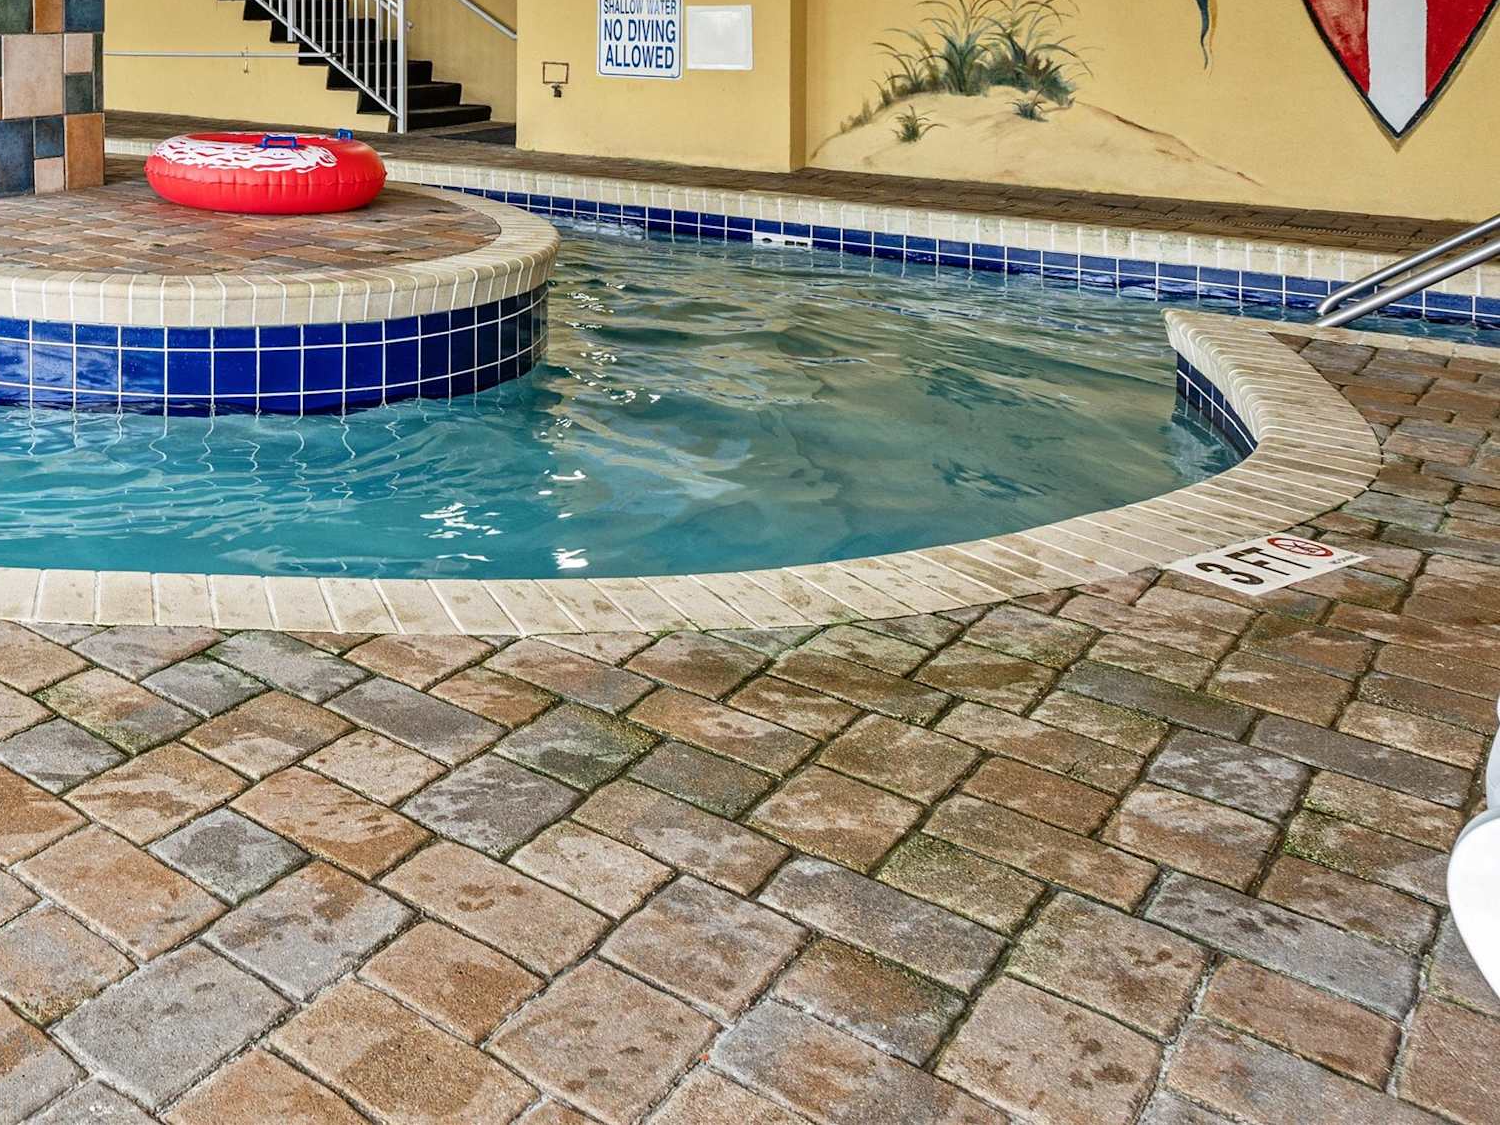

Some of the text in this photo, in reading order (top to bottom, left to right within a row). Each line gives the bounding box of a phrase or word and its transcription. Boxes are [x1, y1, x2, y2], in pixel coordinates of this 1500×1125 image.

[604, 0, 677, 15] SHALLOW WATER
[604, 19, 676, 43] NO DIVING
[605, 44, 674, 69] ALLOWED
[1195, 546, 1312, 585] 3 FT
